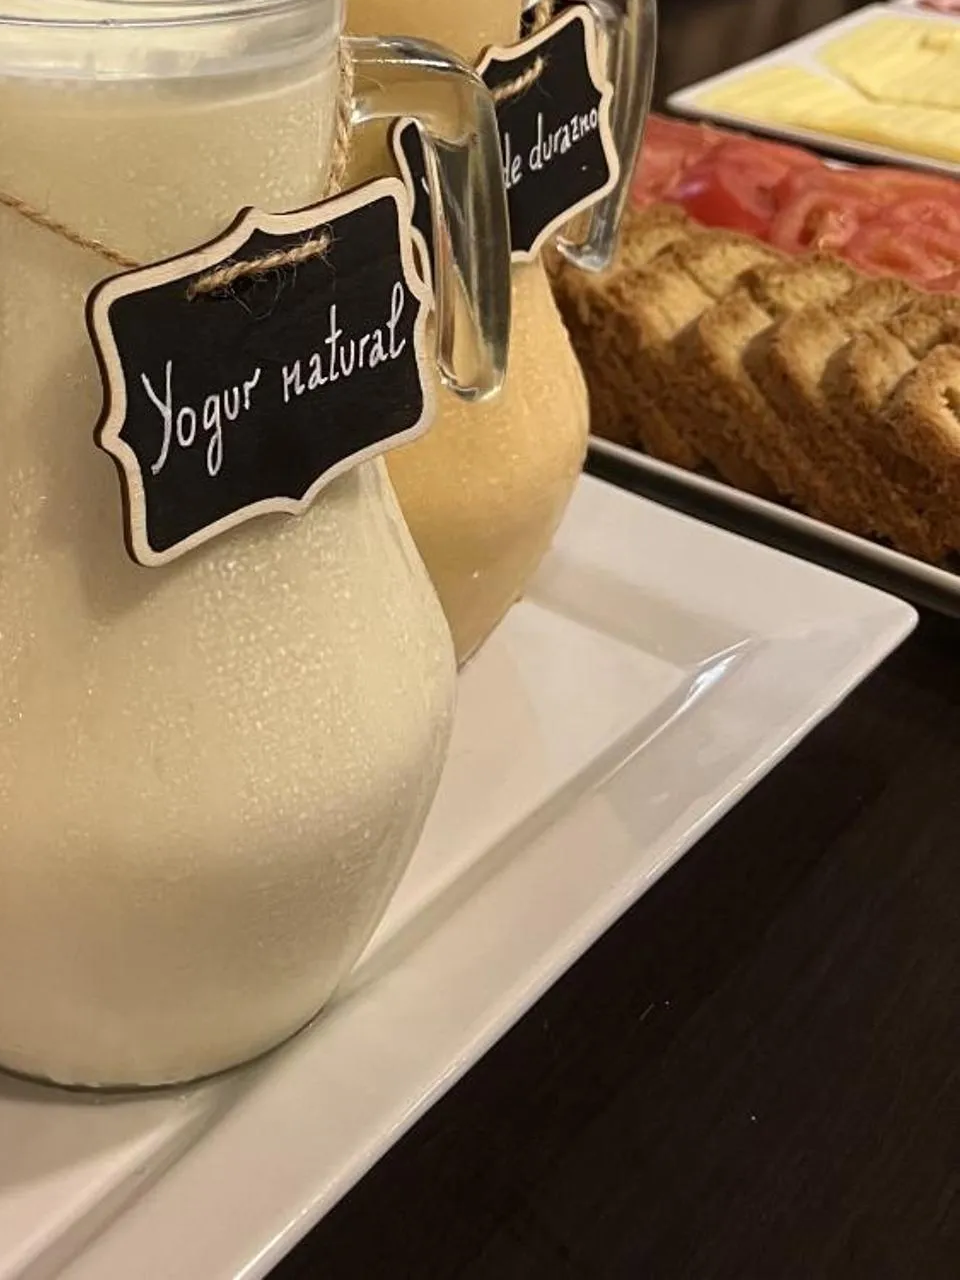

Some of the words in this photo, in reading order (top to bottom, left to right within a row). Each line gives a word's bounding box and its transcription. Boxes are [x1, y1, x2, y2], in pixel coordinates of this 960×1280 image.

[528, 107, 598, 171] durazno
[141, 360, 261, 476] Yogur
[281, 281, 406, 404] natural
